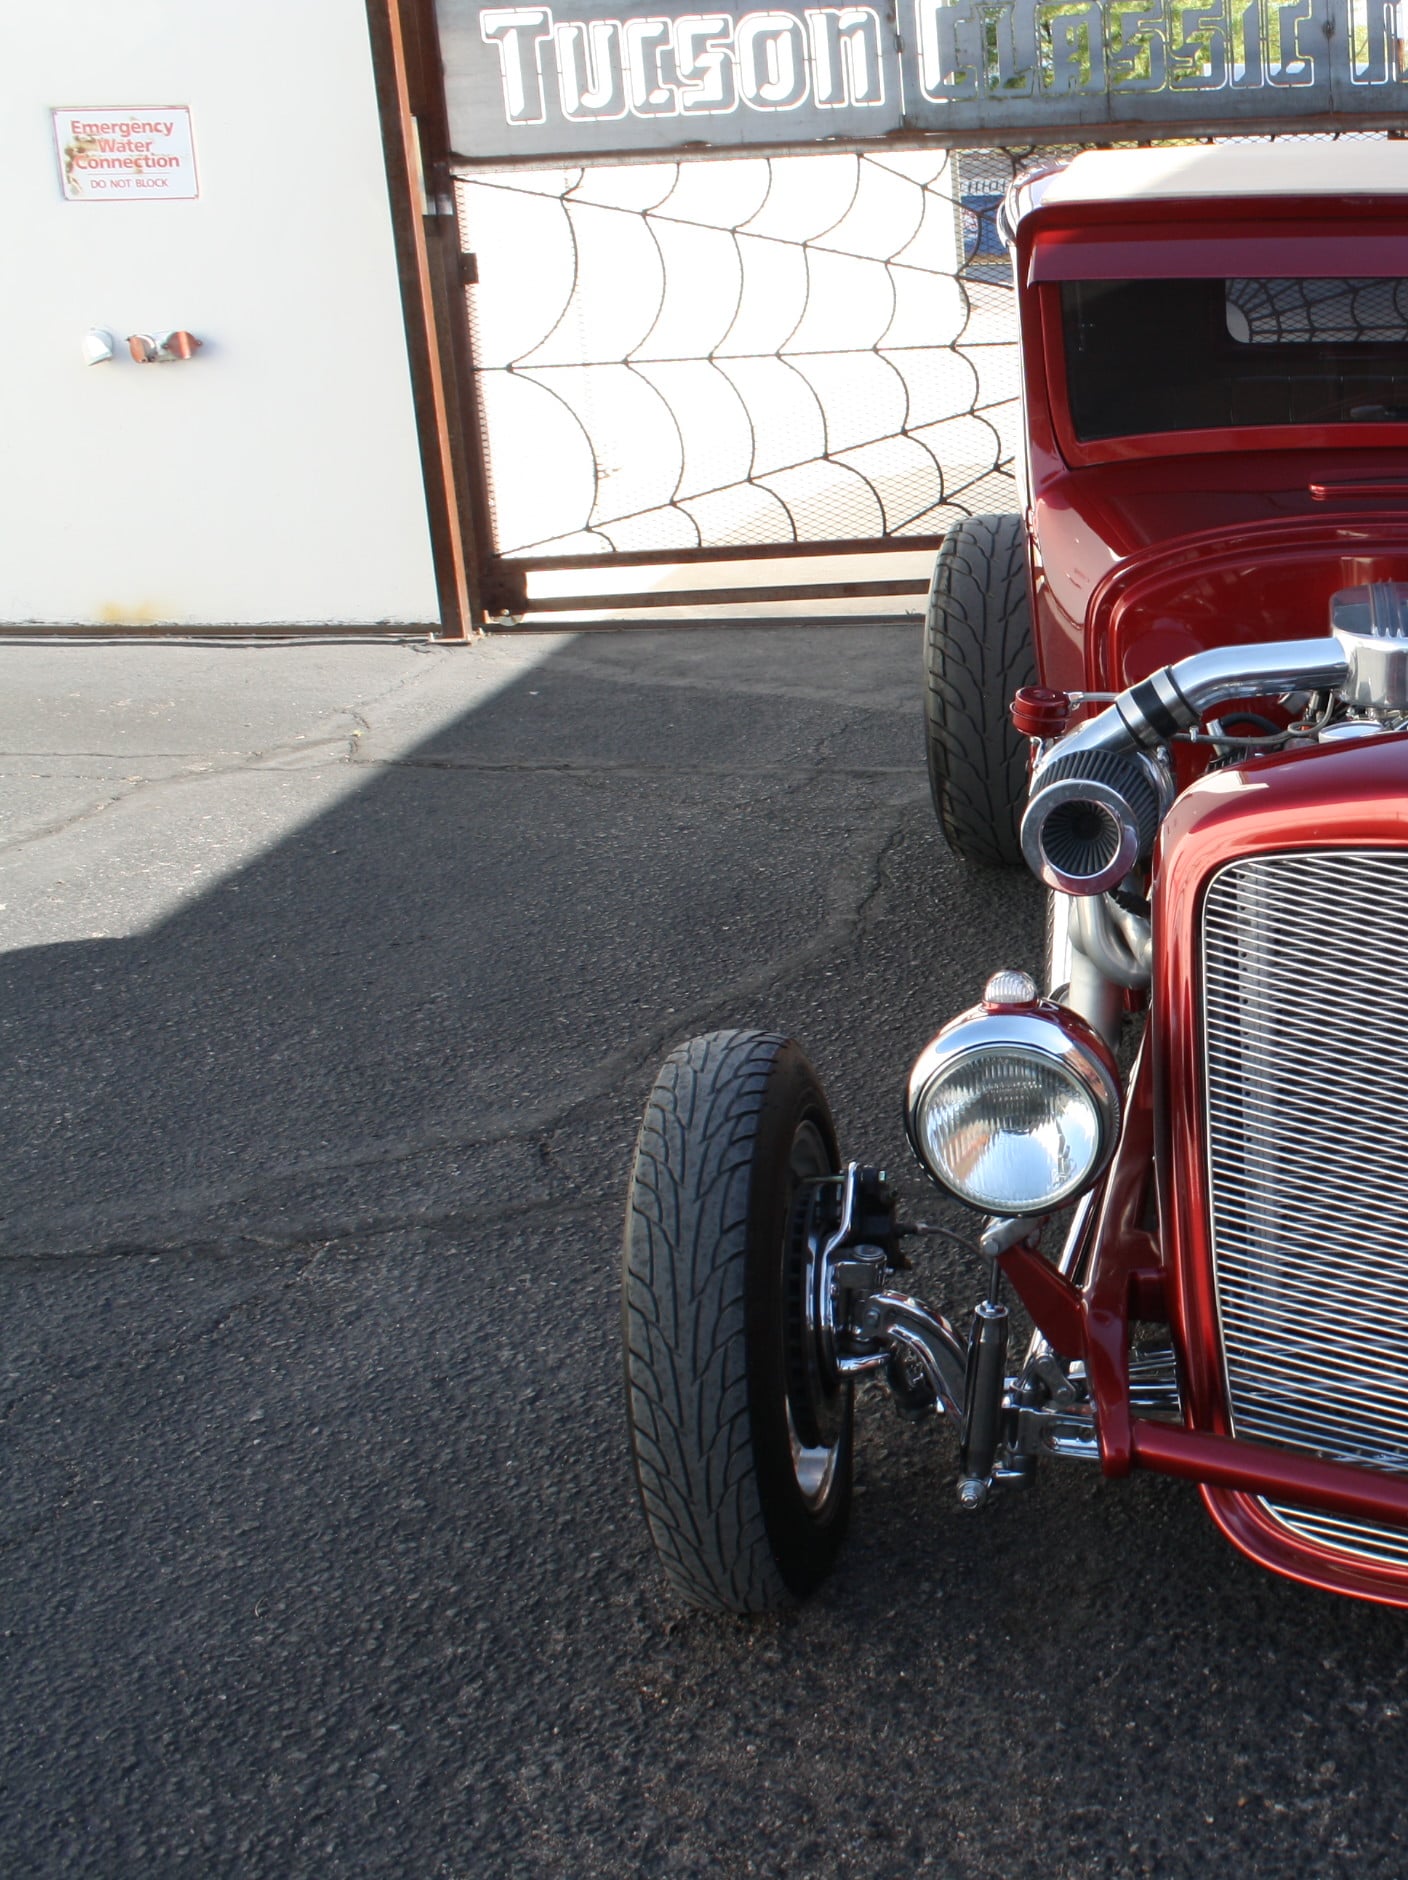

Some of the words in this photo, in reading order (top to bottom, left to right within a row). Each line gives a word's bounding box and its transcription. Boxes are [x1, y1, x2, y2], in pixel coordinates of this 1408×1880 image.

[479, 6, 886, 126] TUCSON
[914, 0, 1315, 103] CLASSIC
[71, 119, 174, 137] Emergency
[97, 138, 153, 154] Water
[74, 154, 180, 170] Connection
[90, 179, 107, 189] DO
[110, 179, 132, 188] NOT
[136, 178, 168, 188] BLOCK
